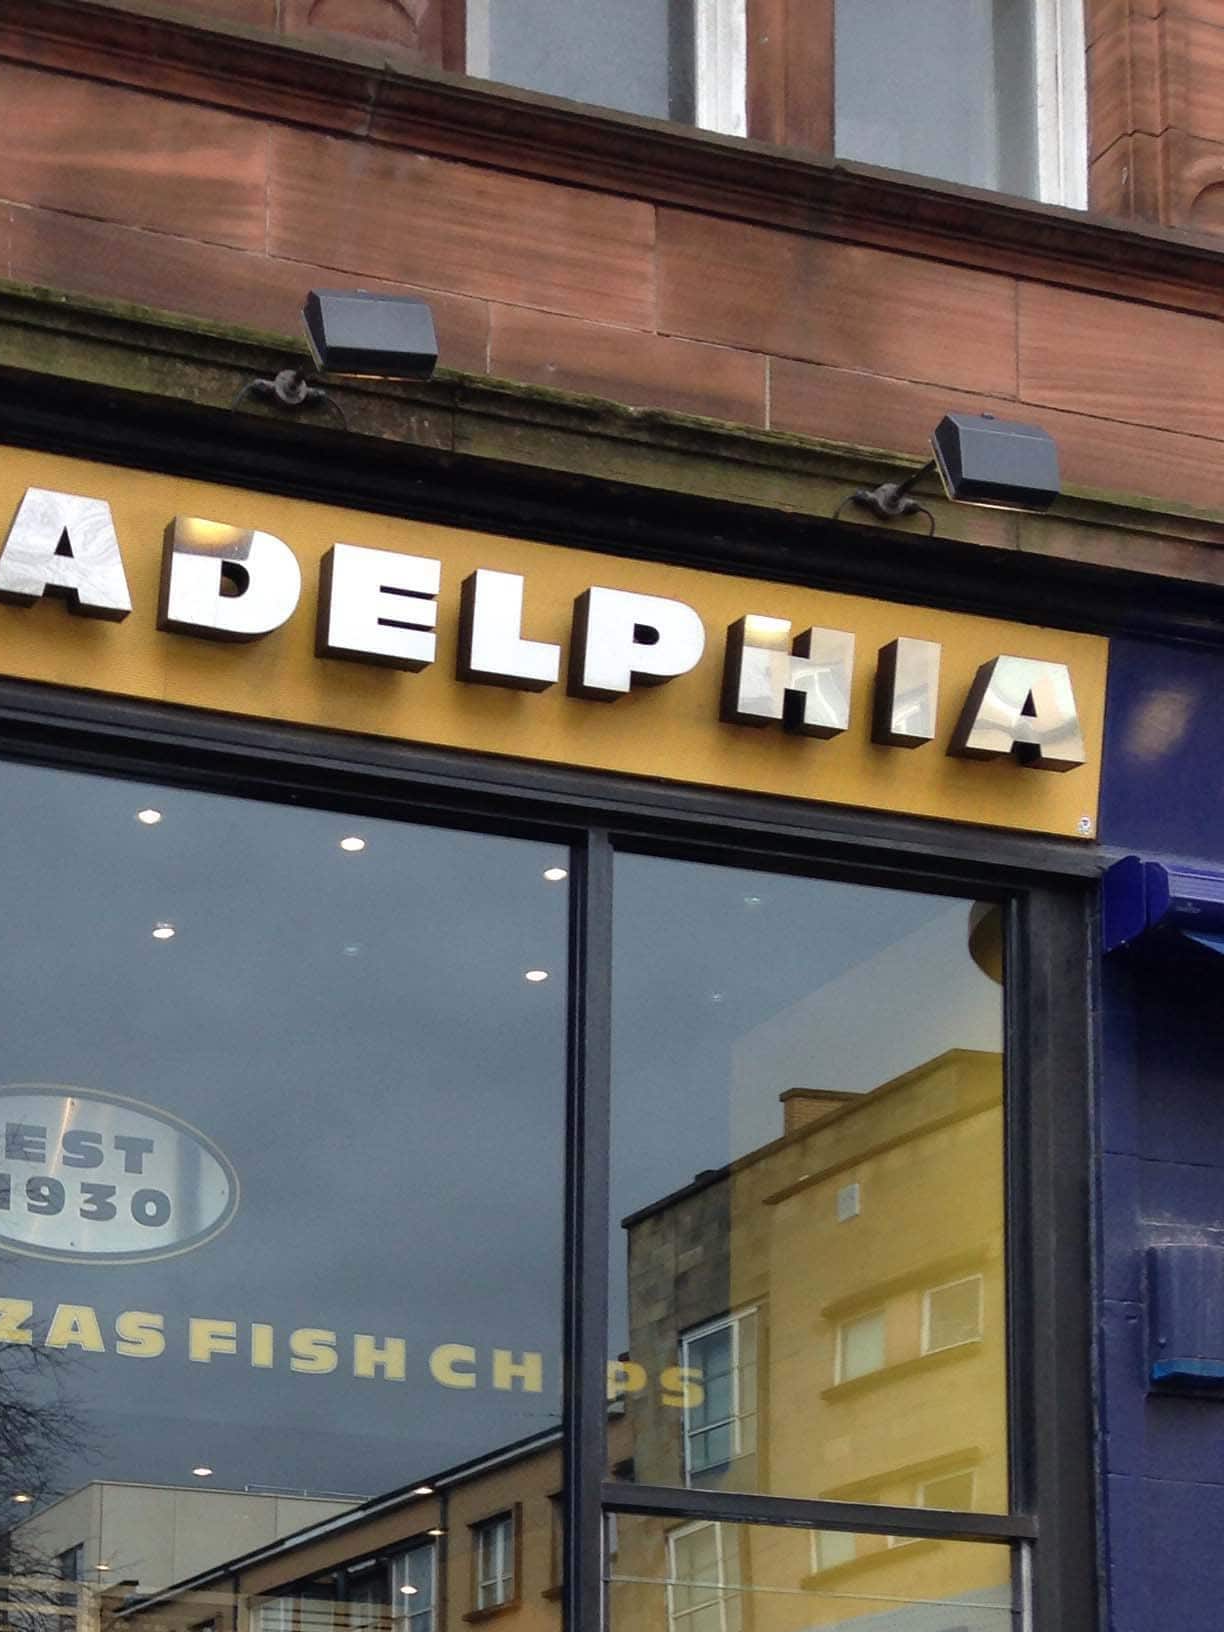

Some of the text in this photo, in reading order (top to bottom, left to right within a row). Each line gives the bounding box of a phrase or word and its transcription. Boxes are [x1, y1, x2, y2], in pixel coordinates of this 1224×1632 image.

[4, 1122, 155, 1175] EST
[187, 1317, 407, 1383] FISH
[428, 1344, 706, 1409] CHPS
